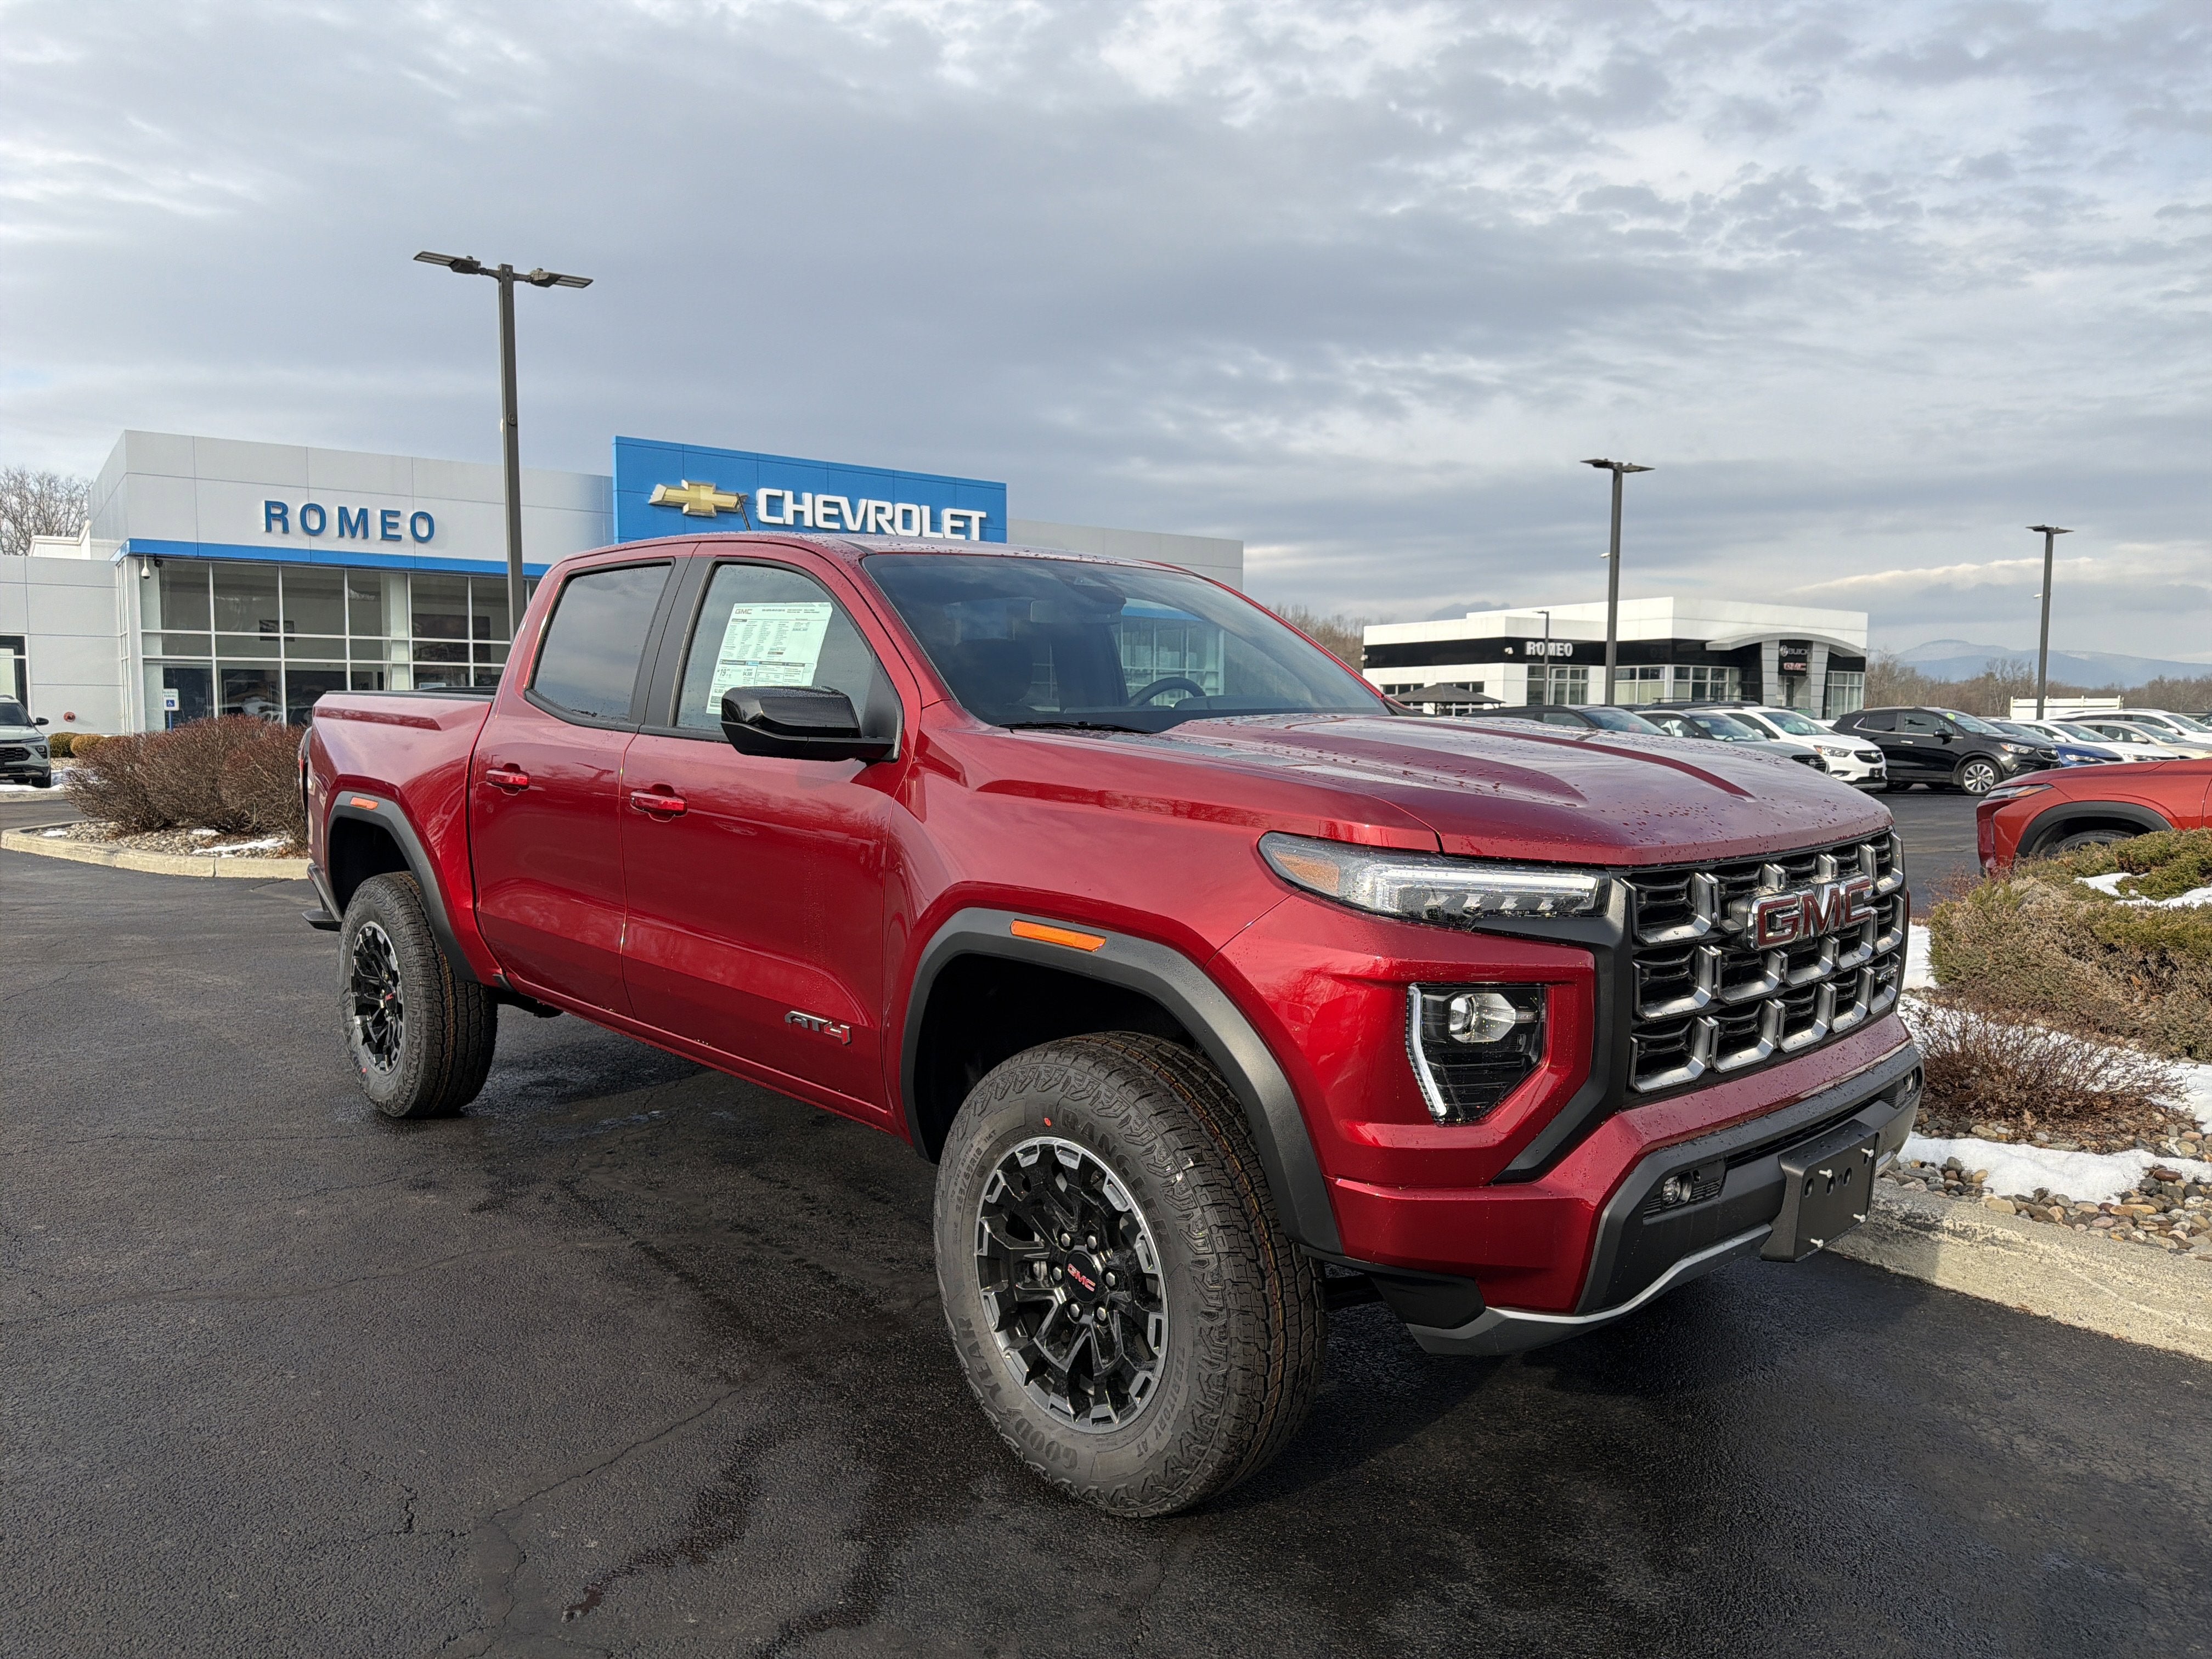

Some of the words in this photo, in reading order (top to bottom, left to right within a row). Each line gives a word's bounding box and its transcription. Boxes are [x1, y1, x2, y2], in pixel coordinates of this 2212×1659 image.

[264, 500, 435, 543] ROMEO
[756, 488, 986, 541] CHEVROLET
[1526, 641, 1573, 657] ROMEO
[720, 668, 727, 676] 19
[1784, 662, 1807, 671] GMC
[1751, 876, 1874, 951] GMC
[785, 1011, 851, 1045] AT4
[1068, 1263, 1096, 1291] GMC
